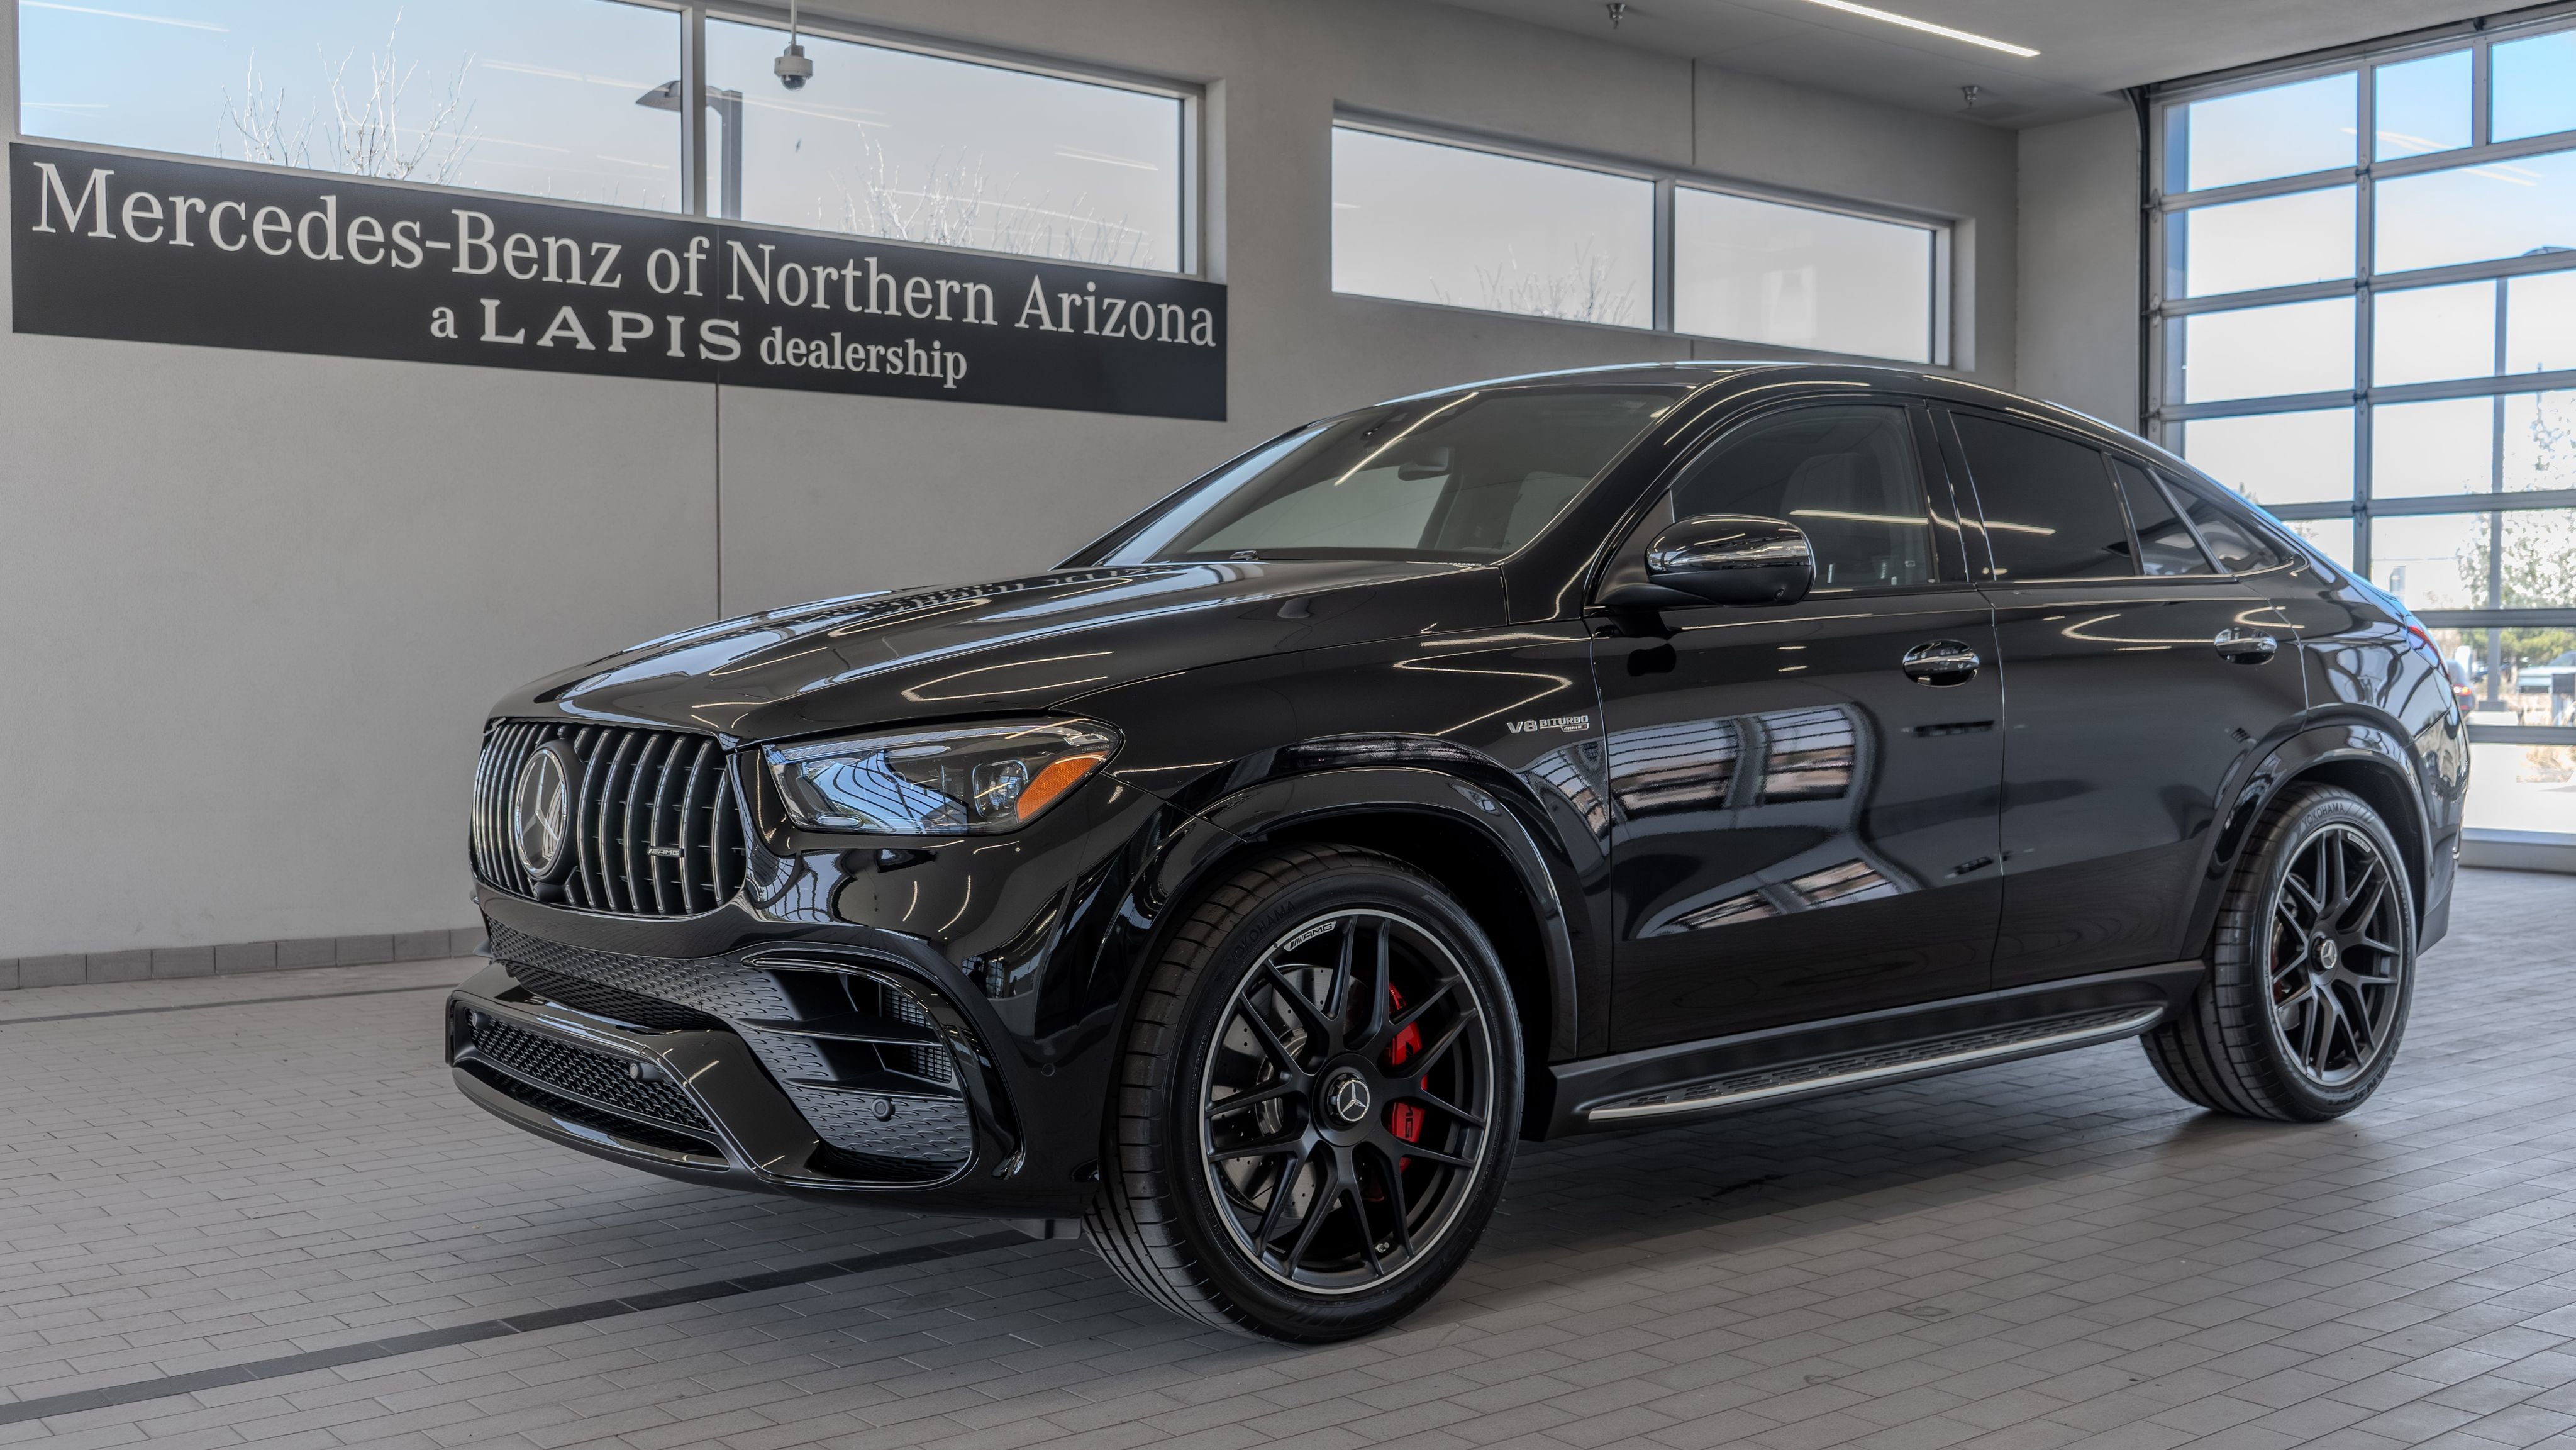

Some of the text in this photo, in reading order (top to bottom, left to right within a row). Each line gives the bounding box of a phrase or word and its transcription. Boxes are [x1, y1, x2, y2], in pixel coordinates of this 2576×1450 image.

[31, 161, 1216, 347] Mercedes-Benz of Northern Arizona
[430, 298, 967, 389] a LAPIS dealership
[1507, 715, 1589, 733] V8 BITURBO
[2302, 802, 2345, 826] YOKOHAMA
